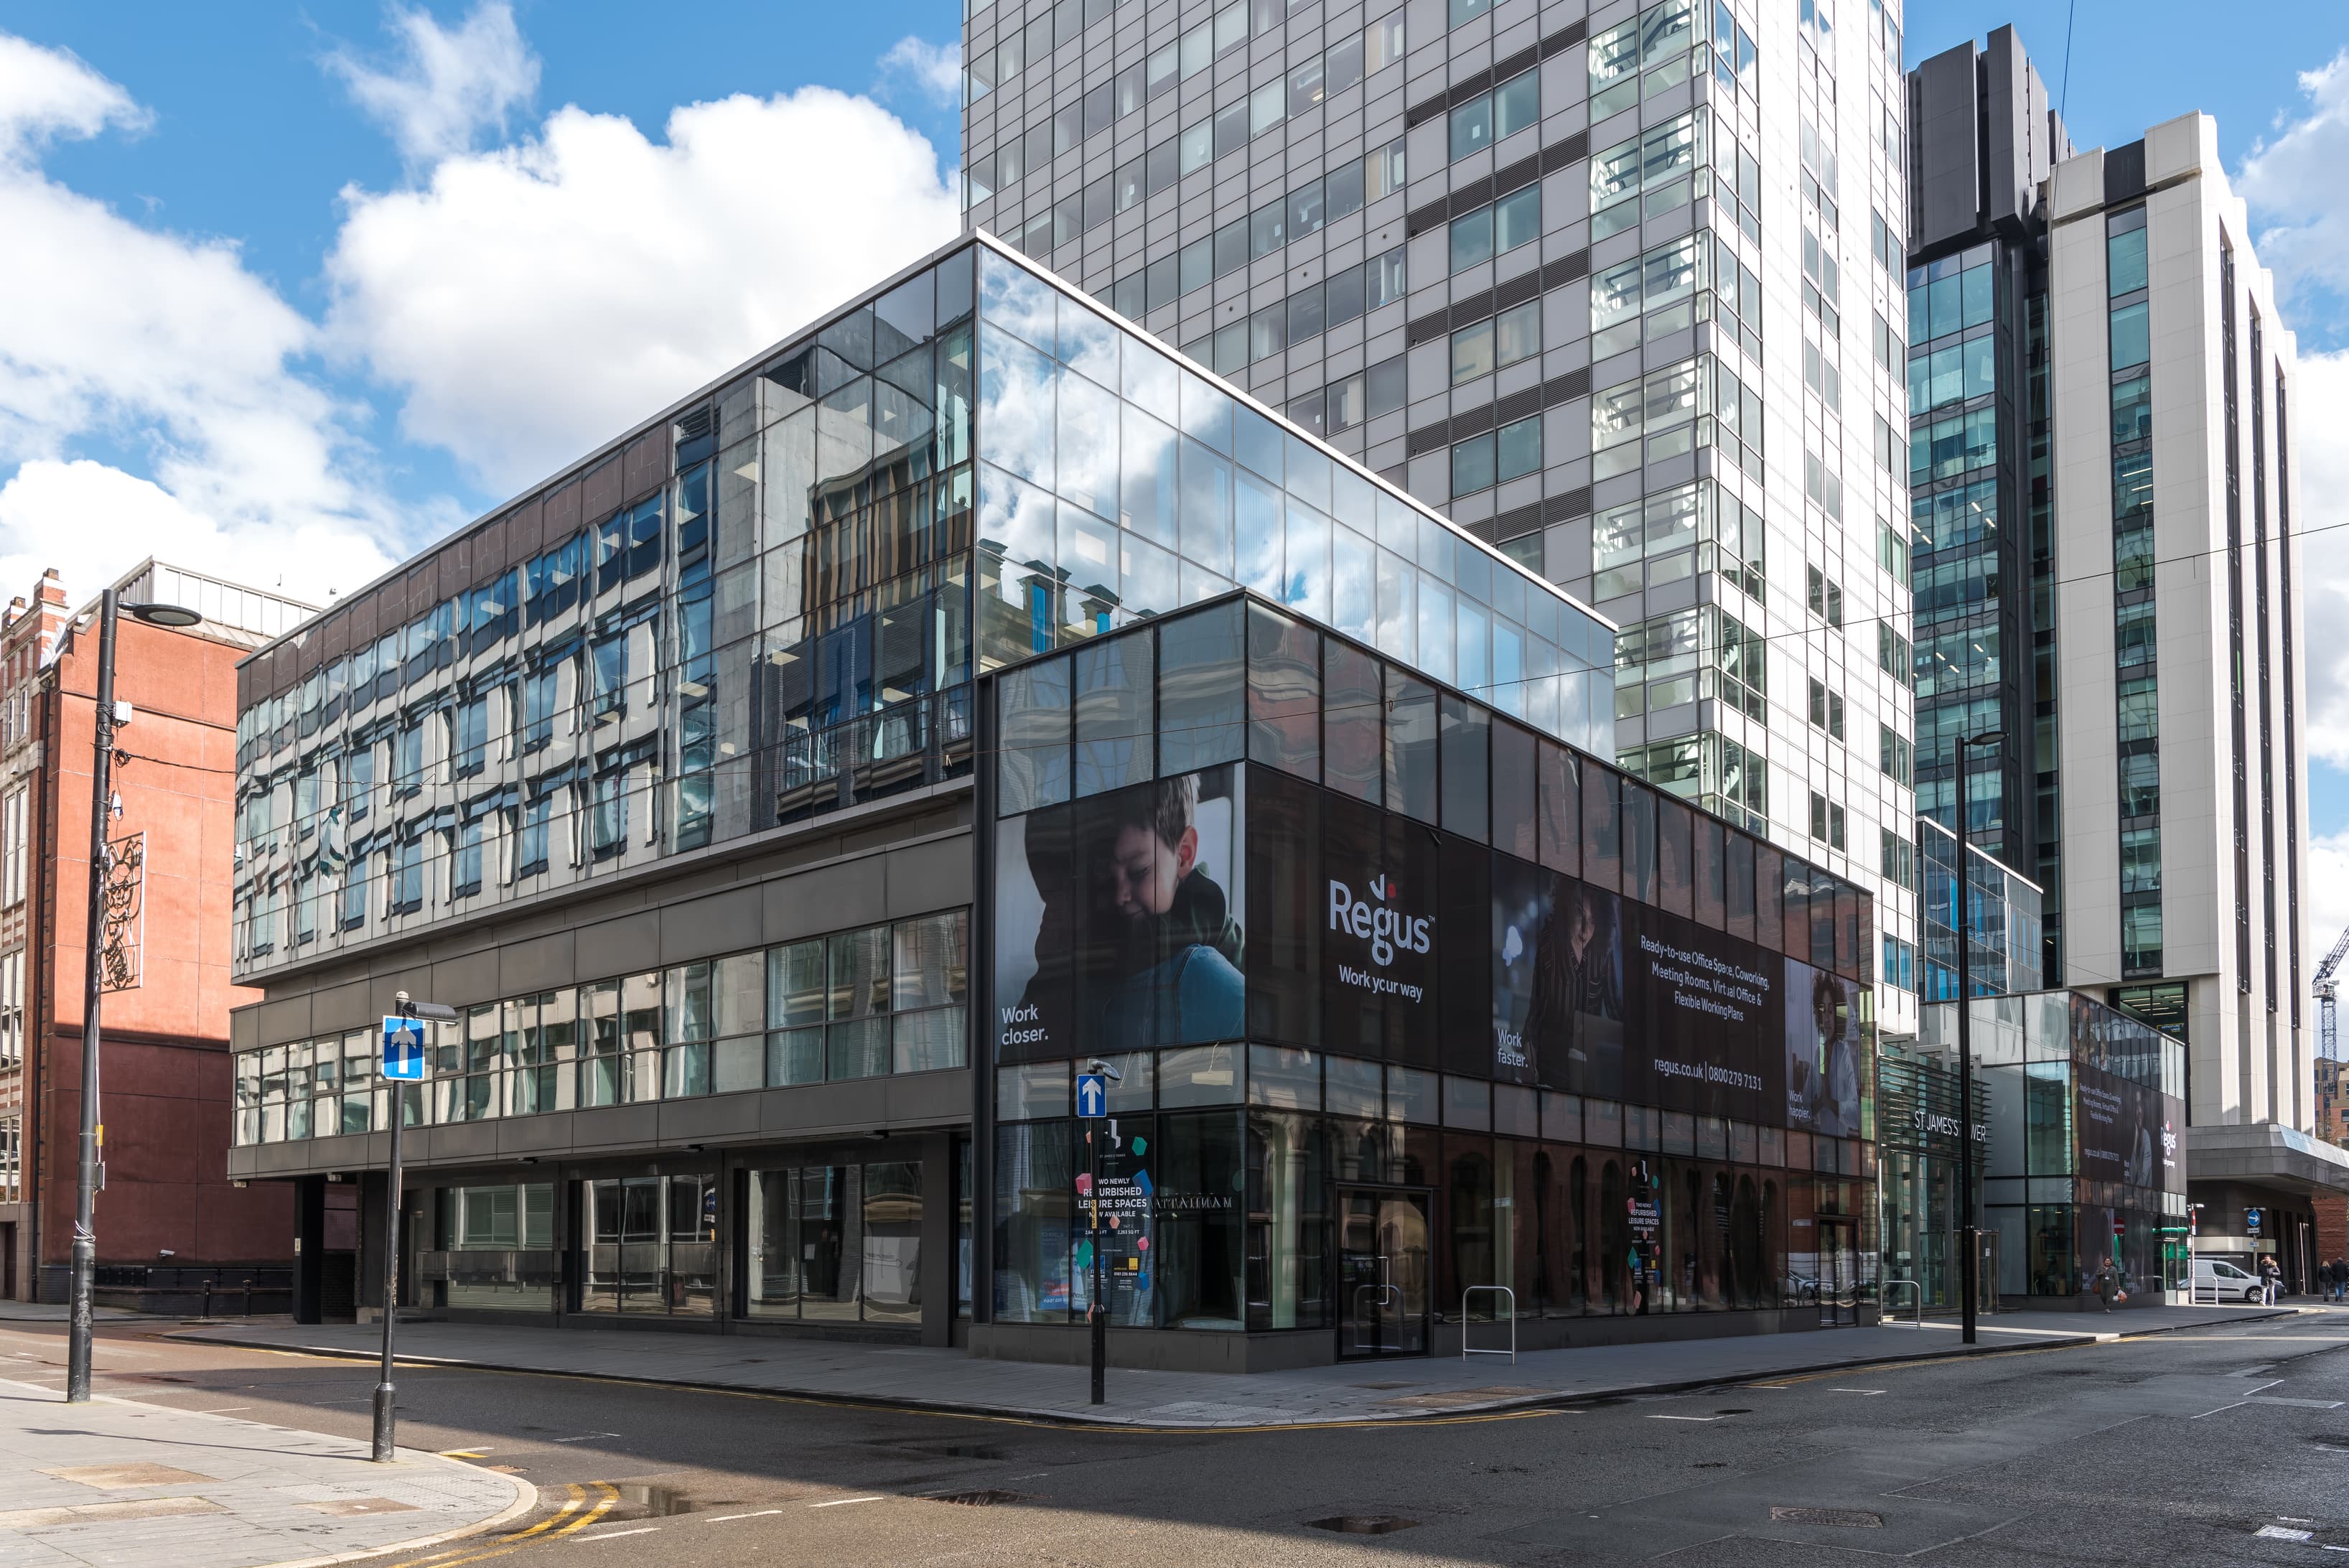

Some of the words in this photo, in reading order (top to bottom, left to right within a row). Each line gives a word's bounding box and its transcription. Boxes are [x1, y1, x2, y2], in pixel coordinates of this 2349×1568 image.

[1641, 935, 1691, 963] Ready-to-use
[1691, 951, 1713, 969] Office
[1735, 966, 1770, 991] Coworking,
[1338, 964, 1371, 989] Work
[1373, 976, 1398, 994] your
[1400, 983, 1423, 1004] way
[1652, 961, 1683, 986] Meeting
[1685, 971, 1712, 994] Rooms,
[1736, 987, 1756, 1004] Office
[1757, 993, 1762, 1007] &
[1001, 1004, 1038, 1024] Work
[1674, 990, 1701, 1010] Flexible
[1701, 997, 1727, 1019] Working
[1728, 1005, 1744, 1022] Plans
[1001, 1027, 1048, 1045] closer.
[1498, 1027, 1522, 1047] Work
[1498, 1047, 1528, 1068] faster.
[1654, 1058, 1704, 1079] regus.co.uk
[1709, 1065, 1728, 1083] 0800
[1729, 1070, 1742, 1086] 279
[1744, 1073, 1762, 1091] 7131
[1788, 1089, 1803, 1103] Work
[1788, 1103, 1811, 1121] happier.
[1915, 1111, 1925, 1131] ST
[1927, 1114, 1958, 1137] JAMES'S
[1959, 1121, 1986, 1142] WER
[1083, 1187, 1142, 1197] REURBISHED
[1078, 1199, 1113, 1209] LEIRE
[1115, 1198, 1147, 1208] SPACES
